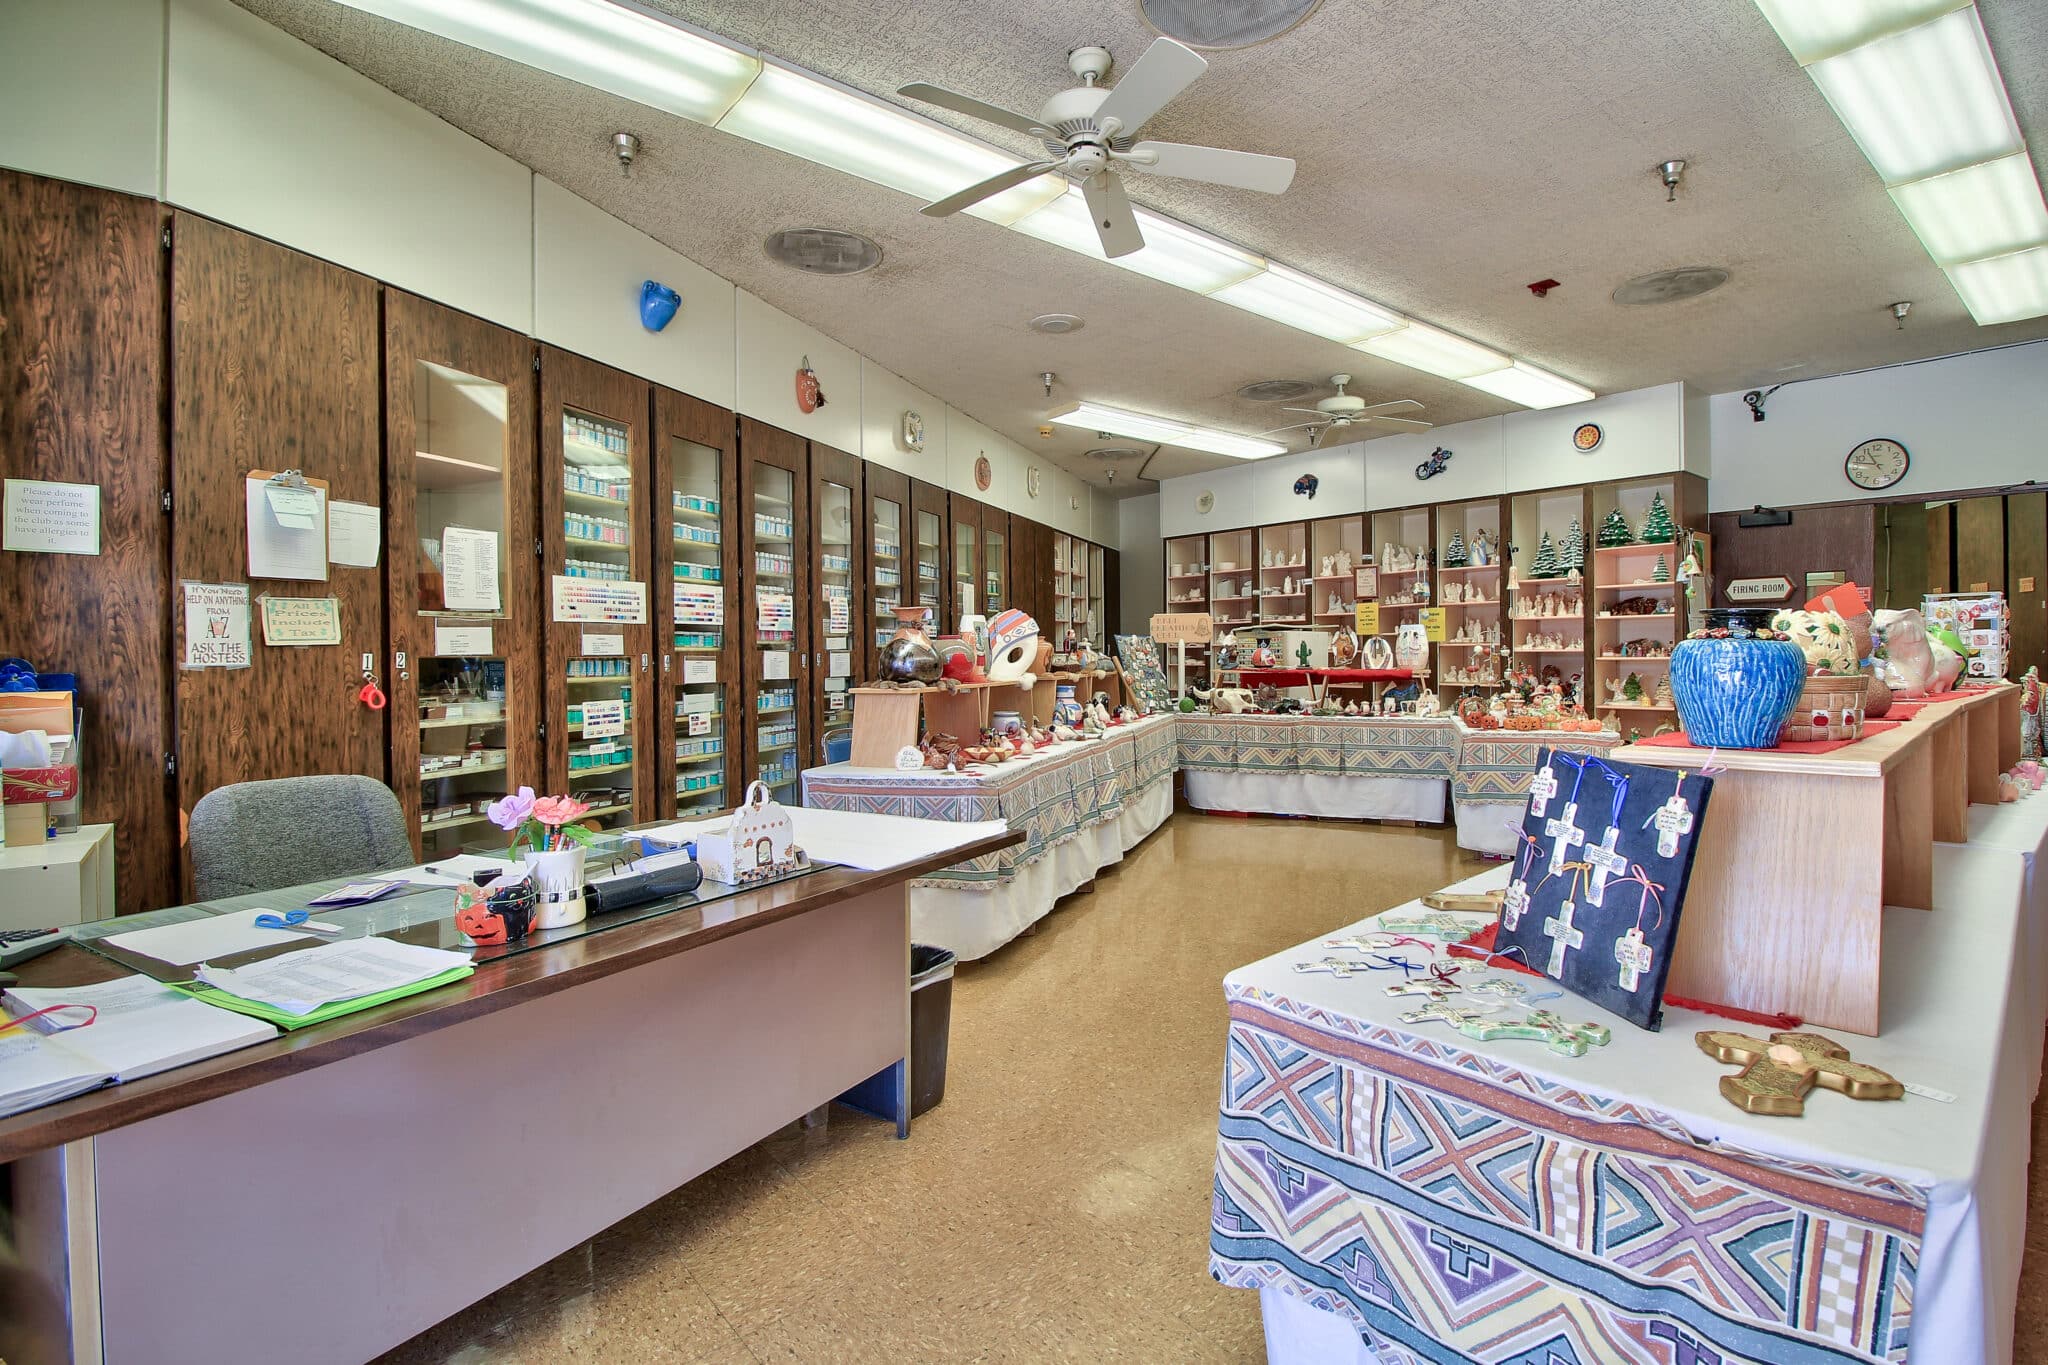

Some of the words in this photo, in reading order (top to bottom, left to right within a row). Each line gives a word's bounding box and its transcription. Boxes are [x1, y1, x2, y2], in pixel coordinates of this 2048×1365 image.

[23, 487, 52, 496] Please
[46, 499, 84, 508] perfume
[44, 508, 78, 518] coming
[32, 516, 51, 525] club
[15, 526, 36, 534] have
[40, 527, 78, 536] allergies
[1732, 585, 1759, 594] FIRING
[1762, 584, 1785, 593] ROOM
[187, 595, 202, 604] HELP
[204, 596, 213, 604] ON
[205, 616, 216, 638] A
[220, 616, 230, 638] Z
[192, 643, 215, 653] ASK
[219, 643, 242, 652] THE
[194, 653, 246, 664] HOSTESS
[364, 655, 370, 668] 1
[398, 654, 404, 667] 2
